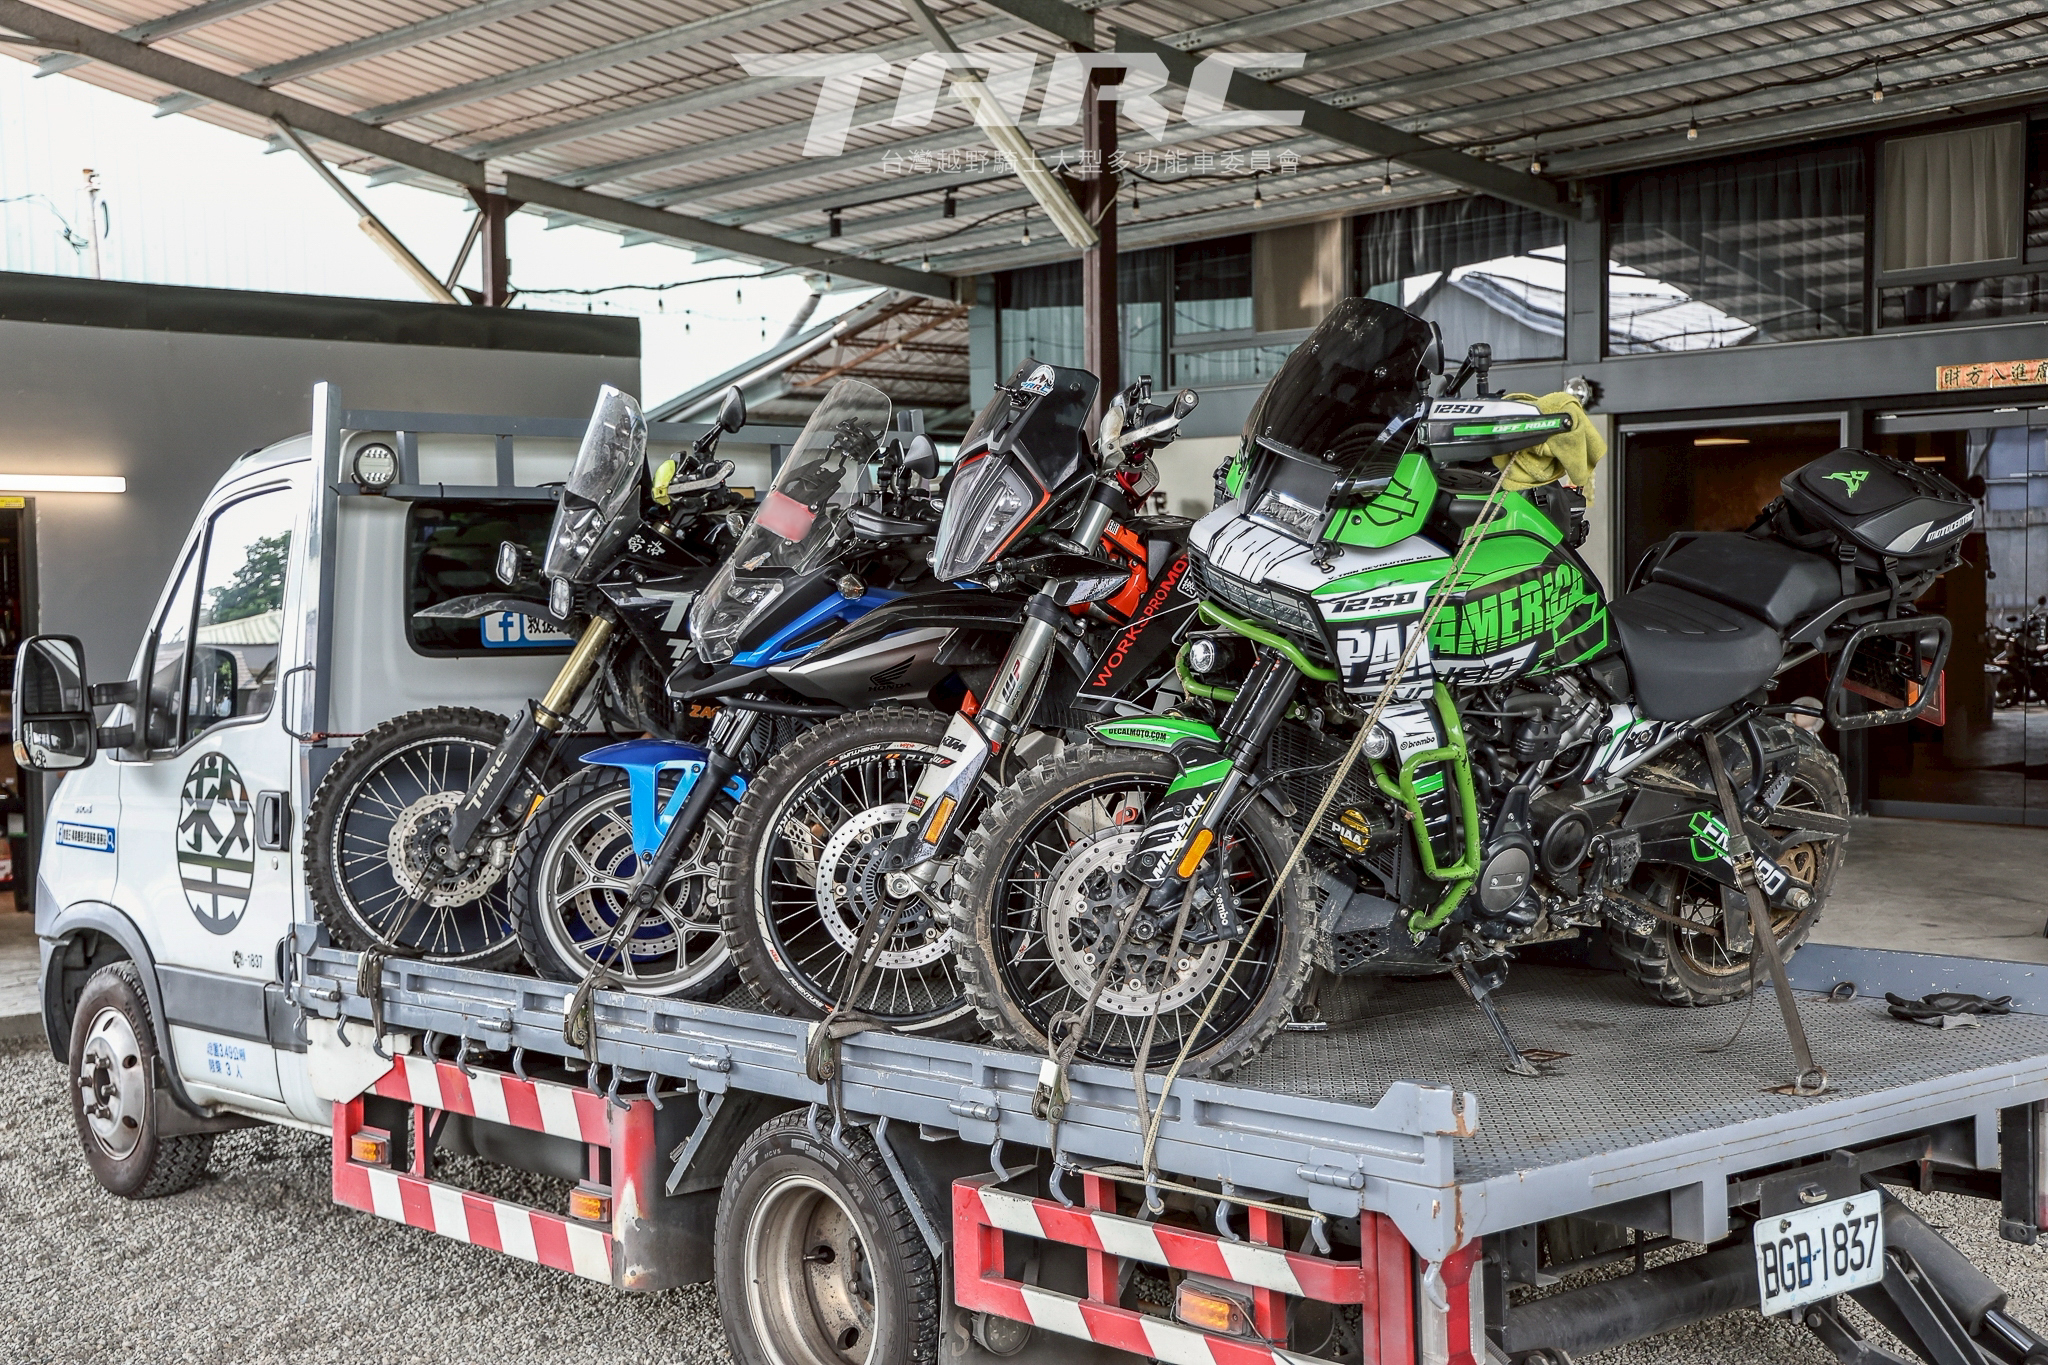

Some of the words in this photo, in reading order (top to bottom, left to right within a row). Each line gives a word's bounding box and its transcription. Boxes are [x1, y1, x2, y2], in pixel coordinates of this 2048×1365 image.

[1434, 404, 1484, 414] 1250
[1492, 424, 1521, 433] OFF
[1524, 420, 1556, 430] ROAD
[1331, 590, 1418, 614] 1250
[1429, 563, 1585, 657] AMERICA
[868, 682, 912, 692] HONDA
[1108, 727, 1167, 740] DECALMOTO.COM
[1408, 736, 1435, 749] brembo
[941, 735, 967, 753] KTM
[464, 751, 507, 811] TARC
[1331, 821, 1362, 846] PIAA
[1761, 1213, 1879, 1299] BGB-1837
